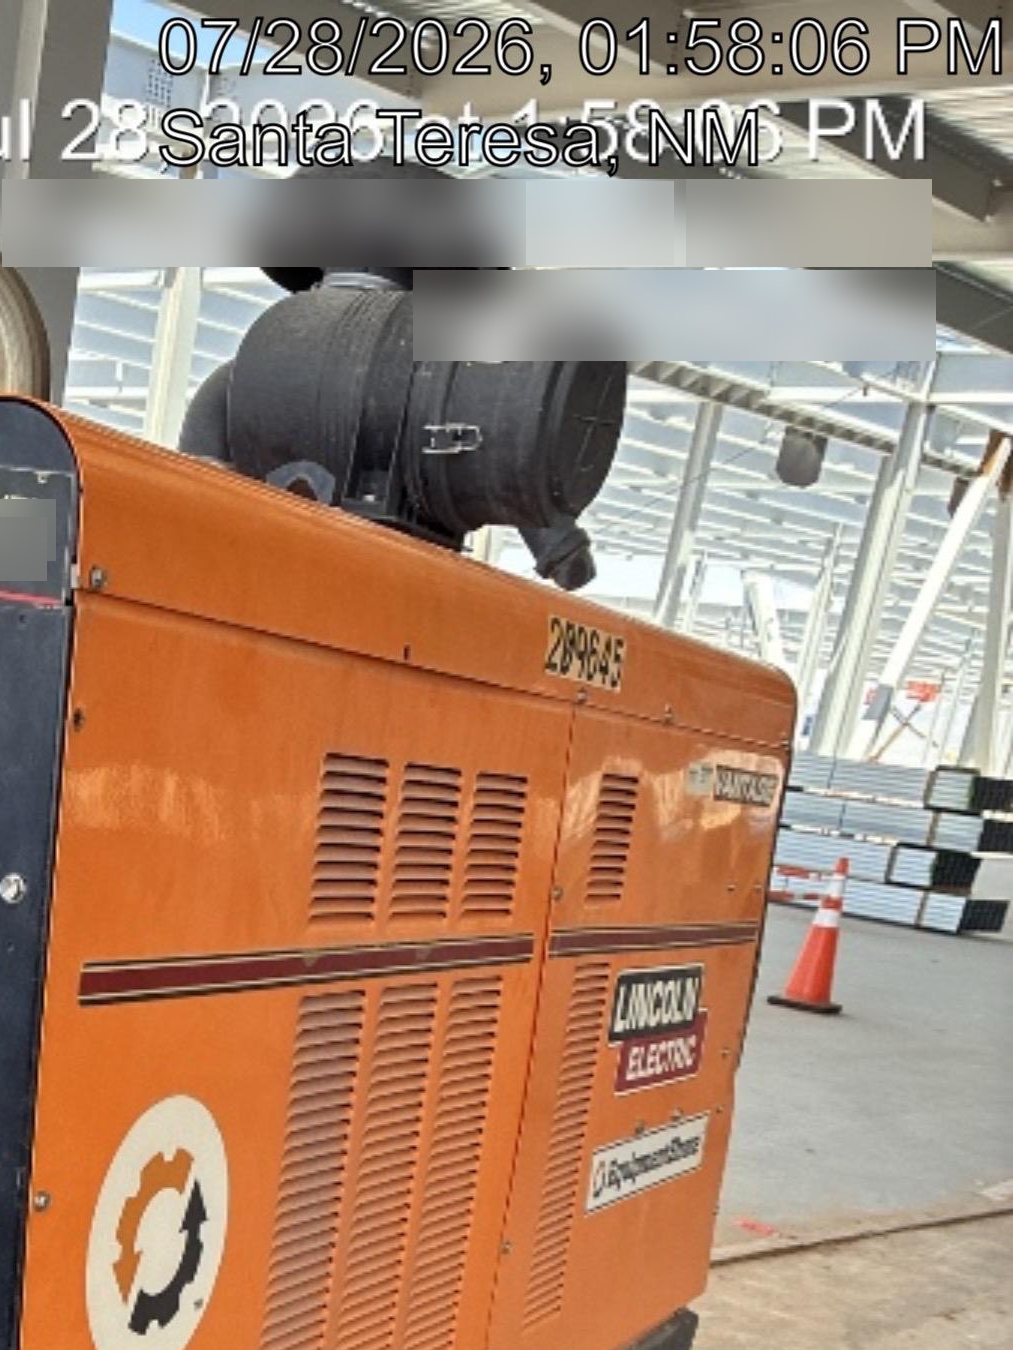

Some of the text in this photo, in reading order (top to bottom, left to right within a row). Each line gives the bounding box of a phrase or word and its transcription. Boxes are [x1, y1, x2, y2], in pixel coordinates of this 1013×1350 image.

[545, 617, 624, 688] 209645
[614, 977, 699, 1033] LINCOLN
[626, 1034, 696, 1081] ELECTRIC
